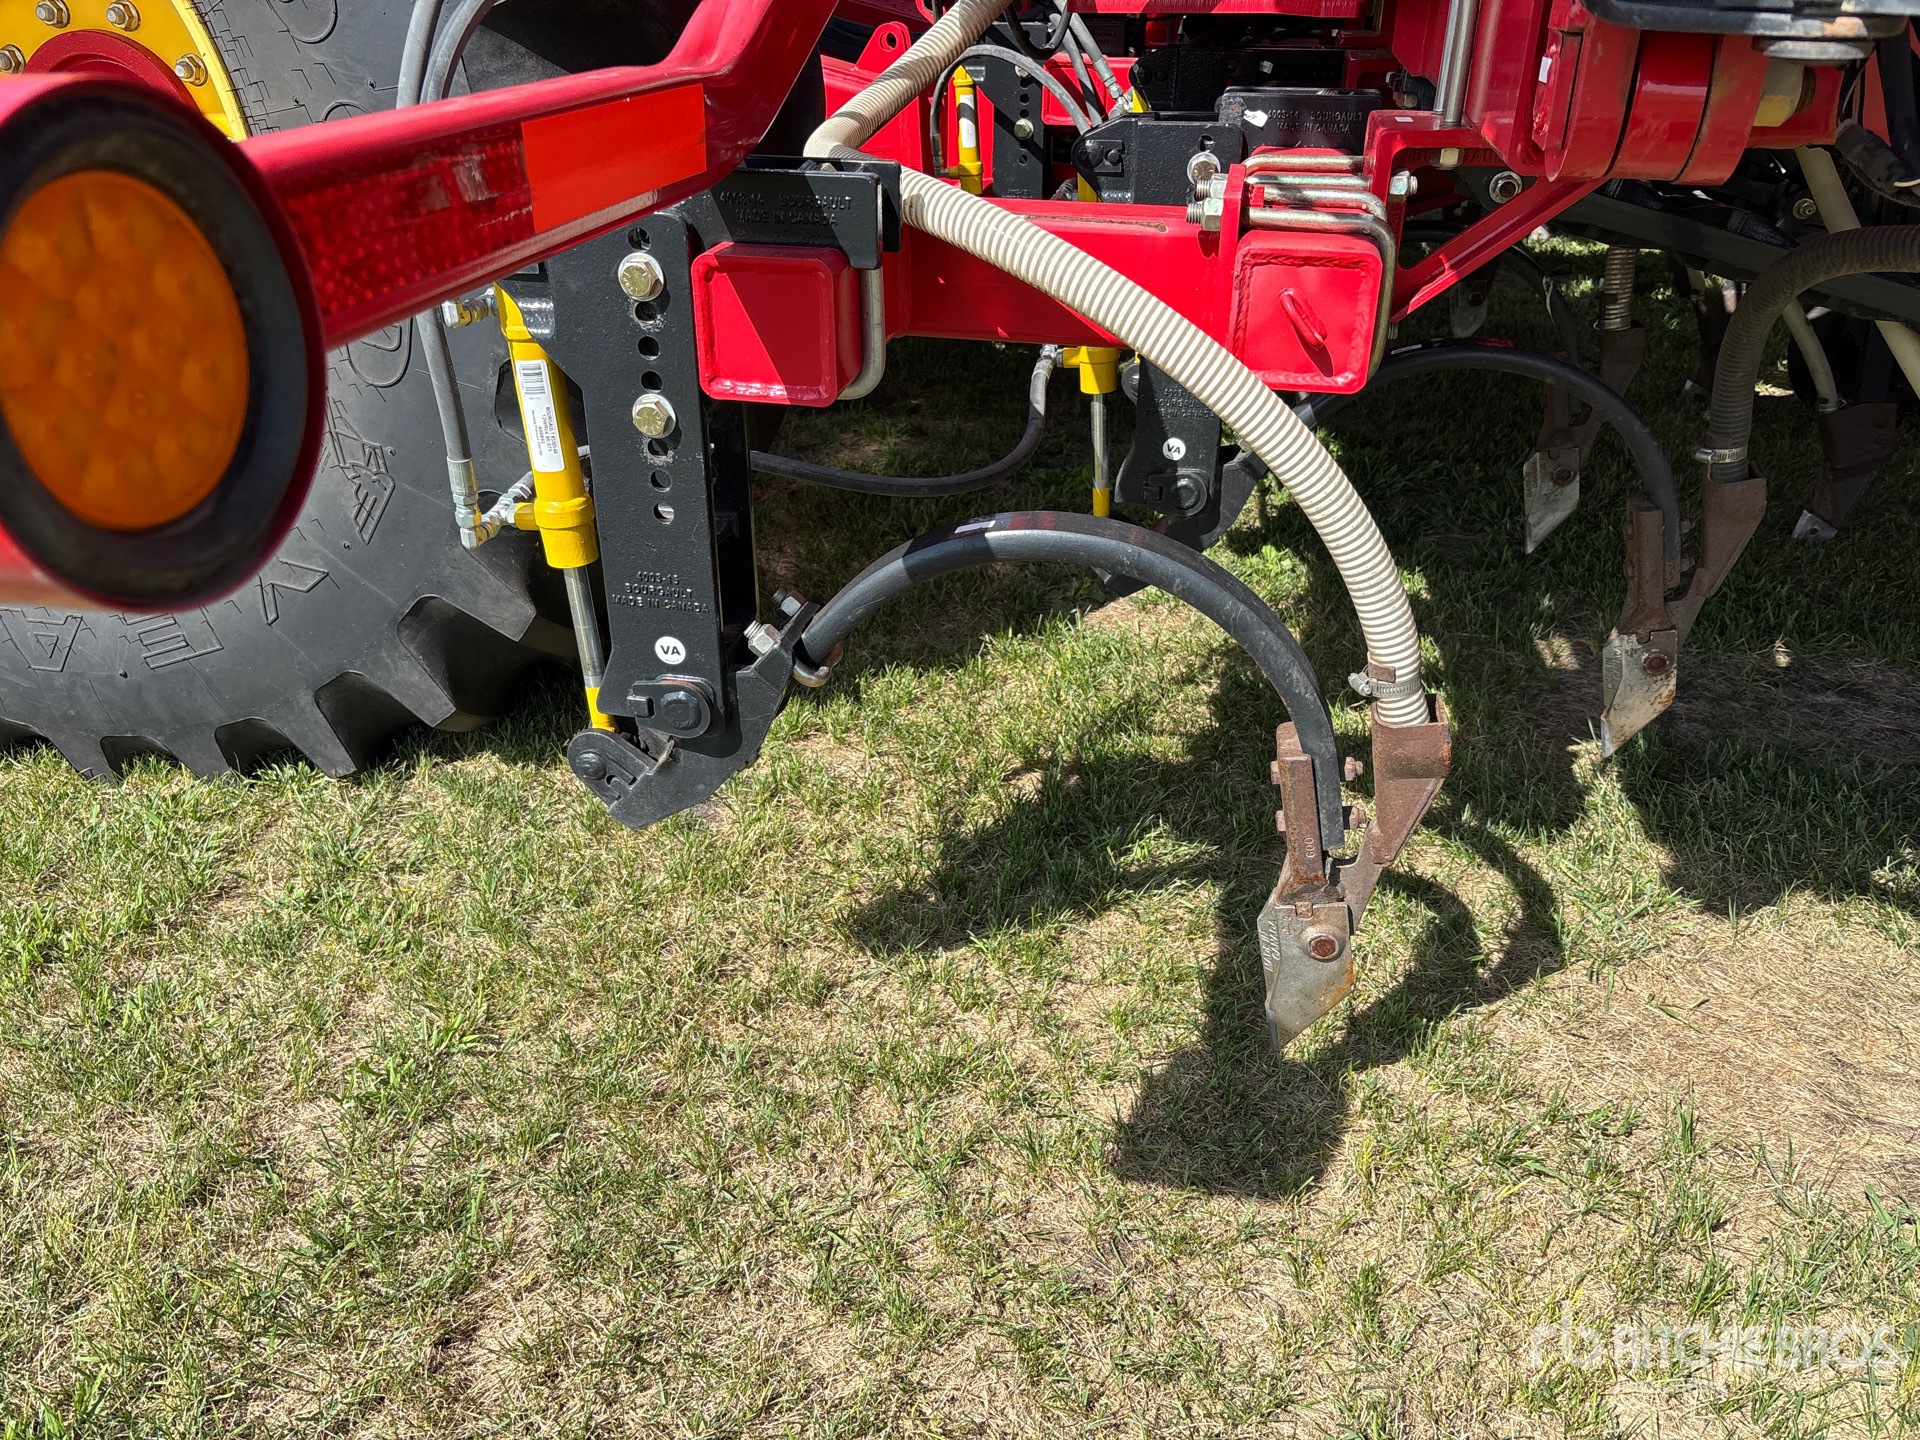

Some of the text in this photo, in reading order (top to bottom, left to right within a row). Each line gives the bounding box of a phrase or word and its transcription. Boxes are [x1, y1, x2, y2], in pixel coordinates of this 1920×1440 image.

[1310, 110, 1362, 121] BOURGAULT
[1276, 122, 1351, 134] MADE IN CANADA
[779, 194, 852, 210] BOURGAULT
[736, 209, 838, 227] MADE IN CANADA
[1154, 399, 1206, 409] BOURGAUL
[1167, 444, 1180, 454] VA
[625, 582, 693, 599] BOURGAULT
[612, 594, 710, 614] MADE IN CANADA
[660, 645, 681, 656] VA
[1303, 837, 1316, 858] 600
